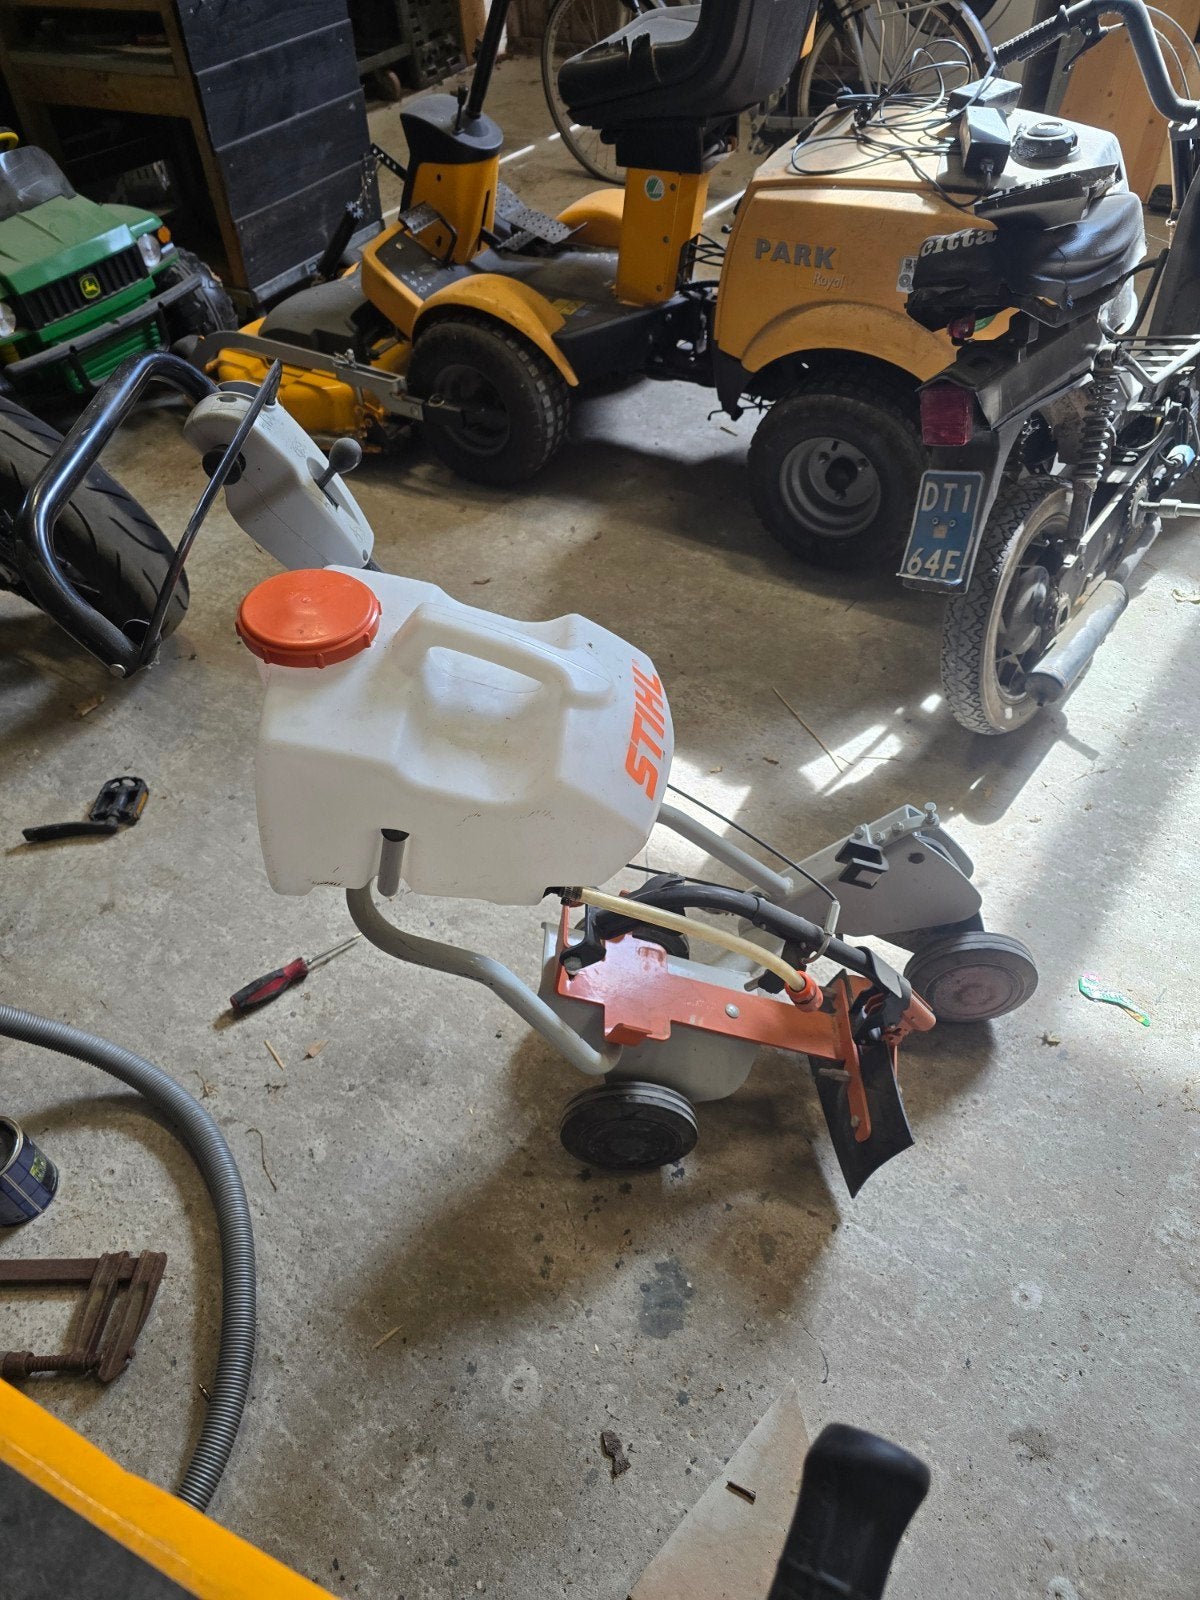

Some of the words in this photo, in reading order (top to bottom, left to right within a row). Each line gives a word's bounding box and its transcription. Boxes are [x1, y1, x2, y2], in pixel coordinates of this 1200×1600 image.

[755, 238, 837, 270] PARK
[813, 271, 846, 291] Royal
[921, 481, 972, 513] DT1
[907, 547, 961, 578] 64F
[625, 665, 665, 801] STIHL
